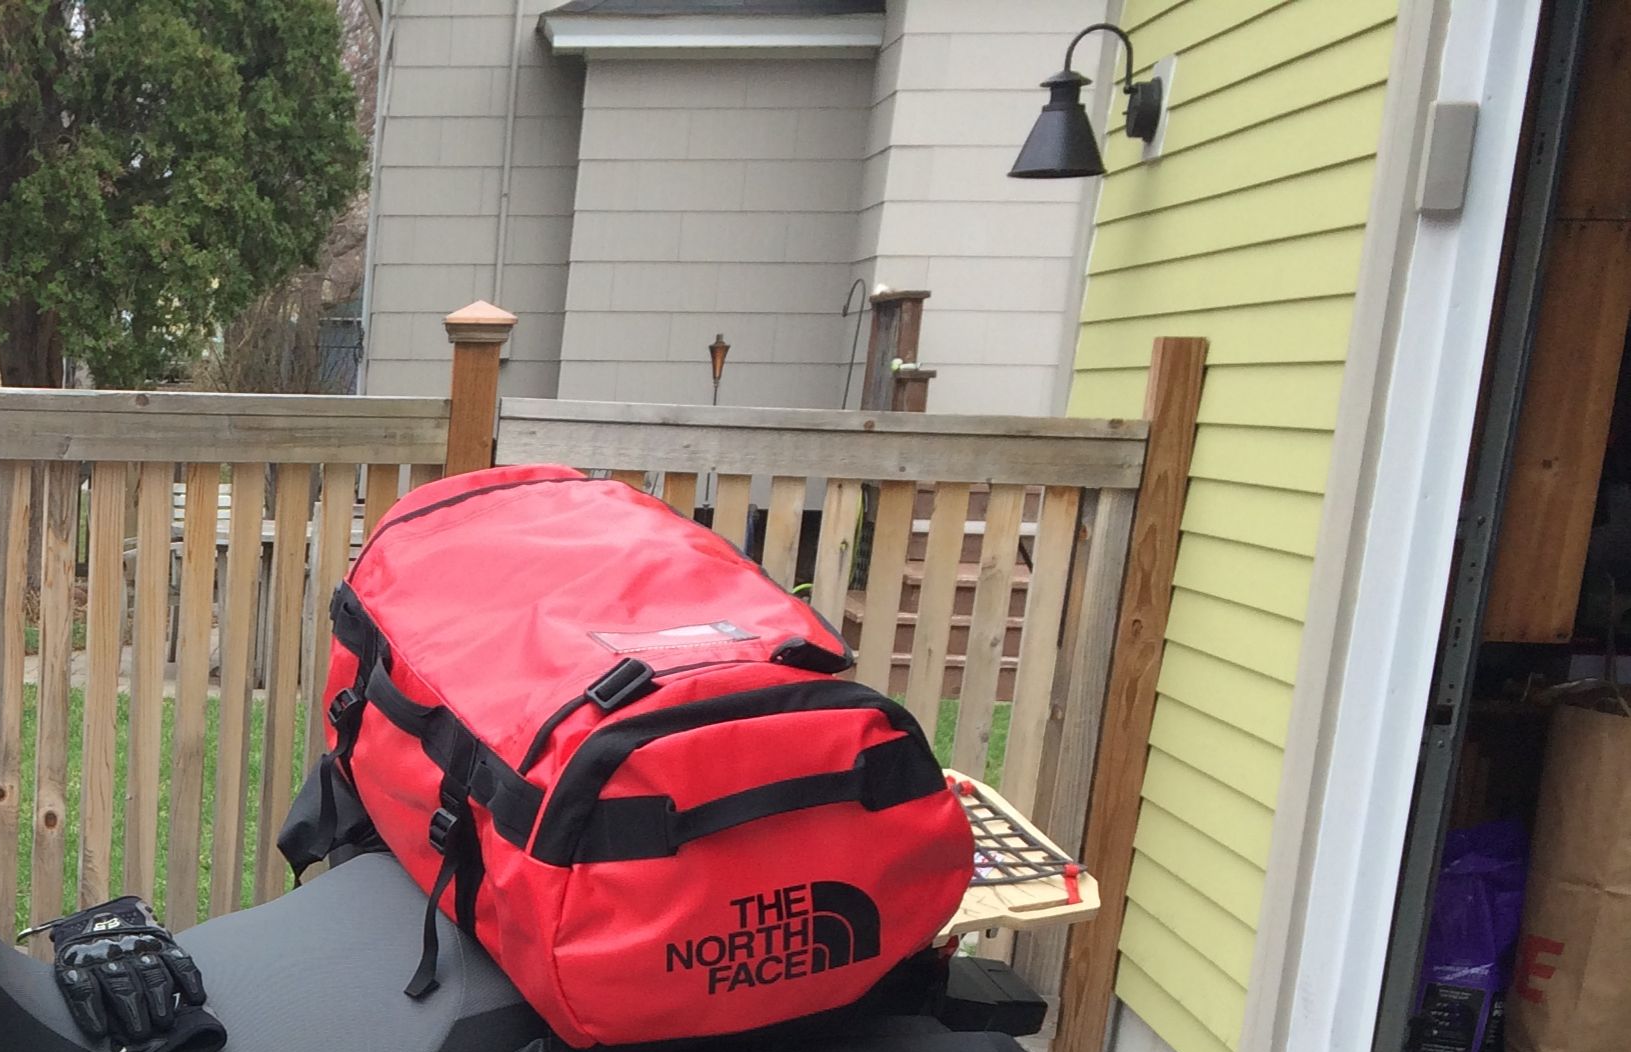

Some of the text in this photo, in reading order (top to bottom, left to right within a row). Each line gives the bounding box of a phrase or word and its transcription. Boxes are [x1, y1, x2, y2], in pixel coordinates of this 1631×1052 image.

[730, 884, 811, 928] THE
[665, 917, 809, 972] NORTH
[708, 950, 809, 995] FACE
